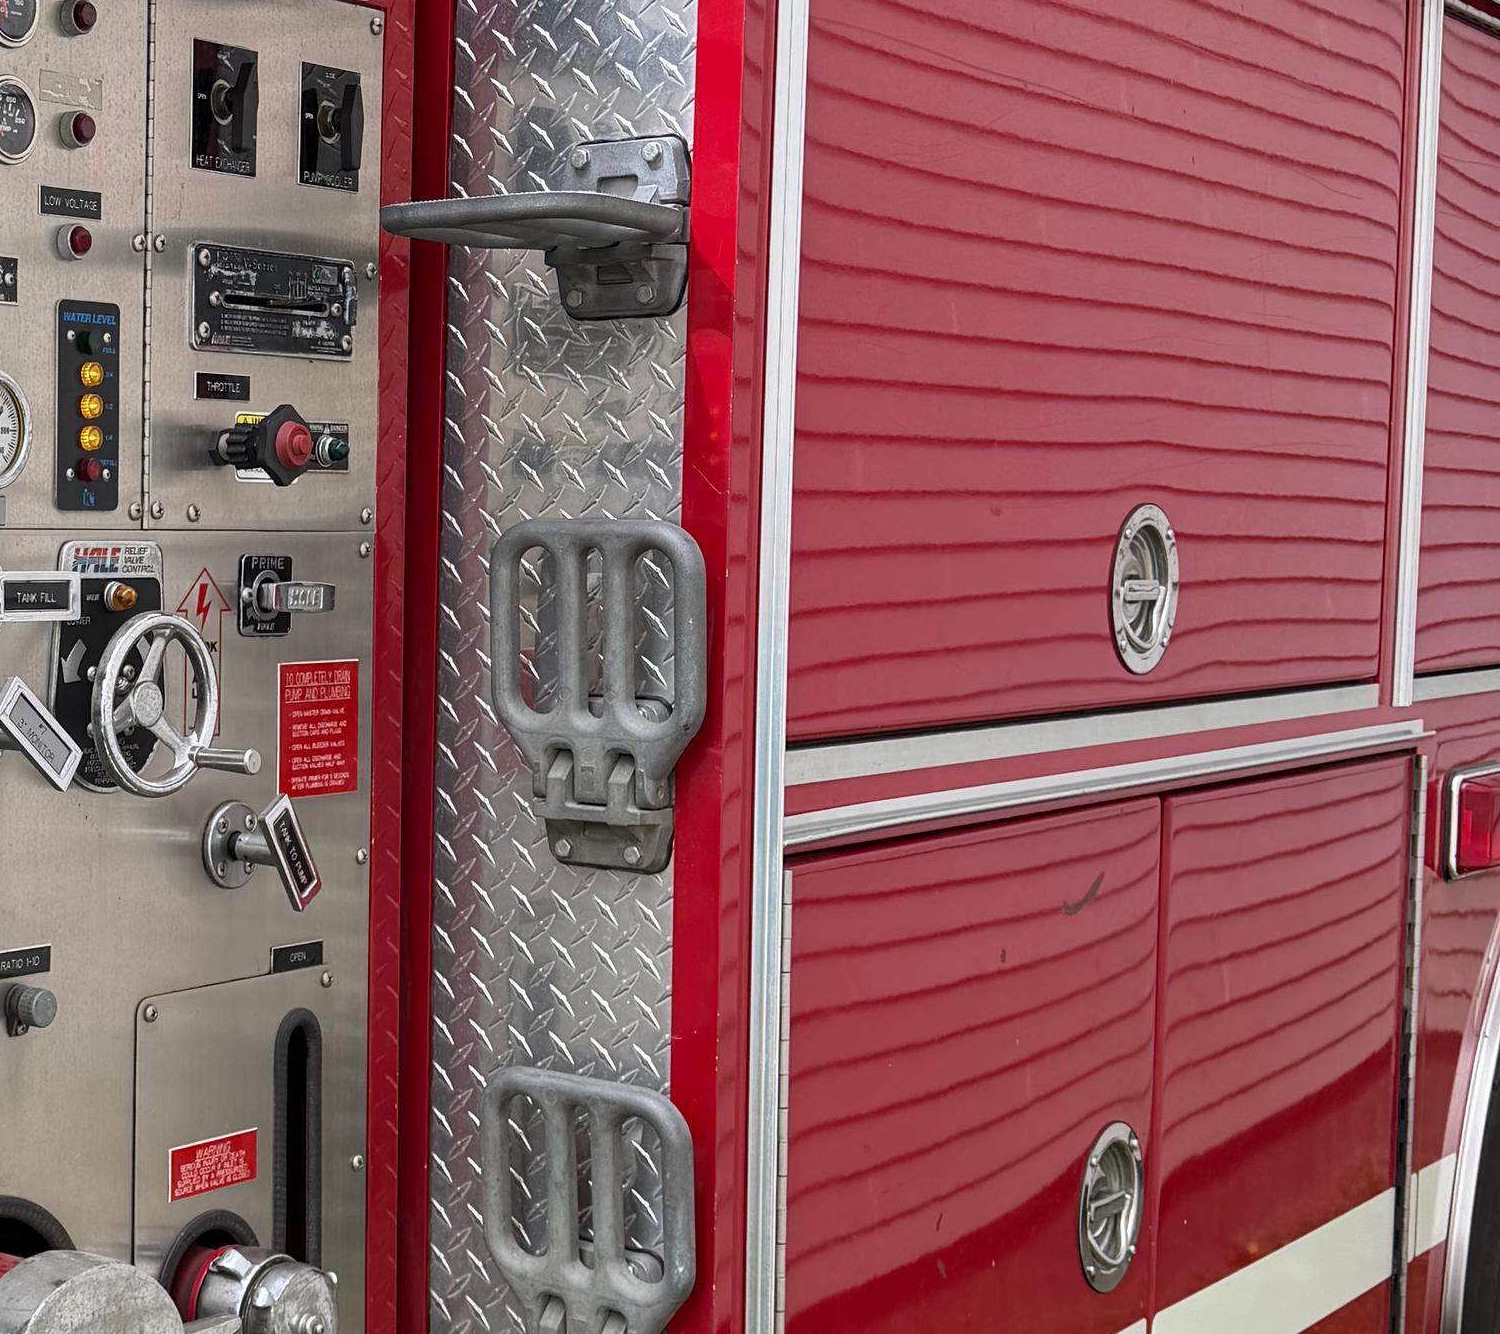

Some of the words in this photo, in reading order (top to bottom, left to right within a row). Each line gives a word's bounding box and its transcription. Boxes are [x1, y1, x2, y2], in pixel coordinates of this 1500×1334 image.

[196, 155, 213, 167] HEAT
[304, 171, 321, 183] PUMP
[45, 195, 61, 207] LOW
[64, 198, 97, 211] VOLTAGE
[63, 312, 91, 323] WATER
[92, 313, 116, 324] LEVEL
[207, 382, 240, 393] THROTTLE
[124, 556, 144, 564] VALVE
[252, 557, 284, 569] PRIME
[122, 565, 154, 573] CONTROL
[17, 592, 37, 602] TANK
[40, 592, 56, 602] FILL
[286, 673, 294, 685] TO
[296, 671, 332, 685] COMPLETELY
[334, 670, 350, 683] DRAIN
[285, 688, 302, 701] PUMP
[305, 688, 318, 699] AND
[320, 685, 350, 699] PLUMBING
[38, 724, 48, 735] #7
[26, 727, 55, 763] MONITOR
[279, 822, 292, 847] TANK
[290, 847, 298, 861] TO
[295, 861, 307, 885] PUMP
[290, 952, 306, 962] OPEN
[1, 959, 23, 971] RATIO
[196, 1141, 231, 1159] WARNING
